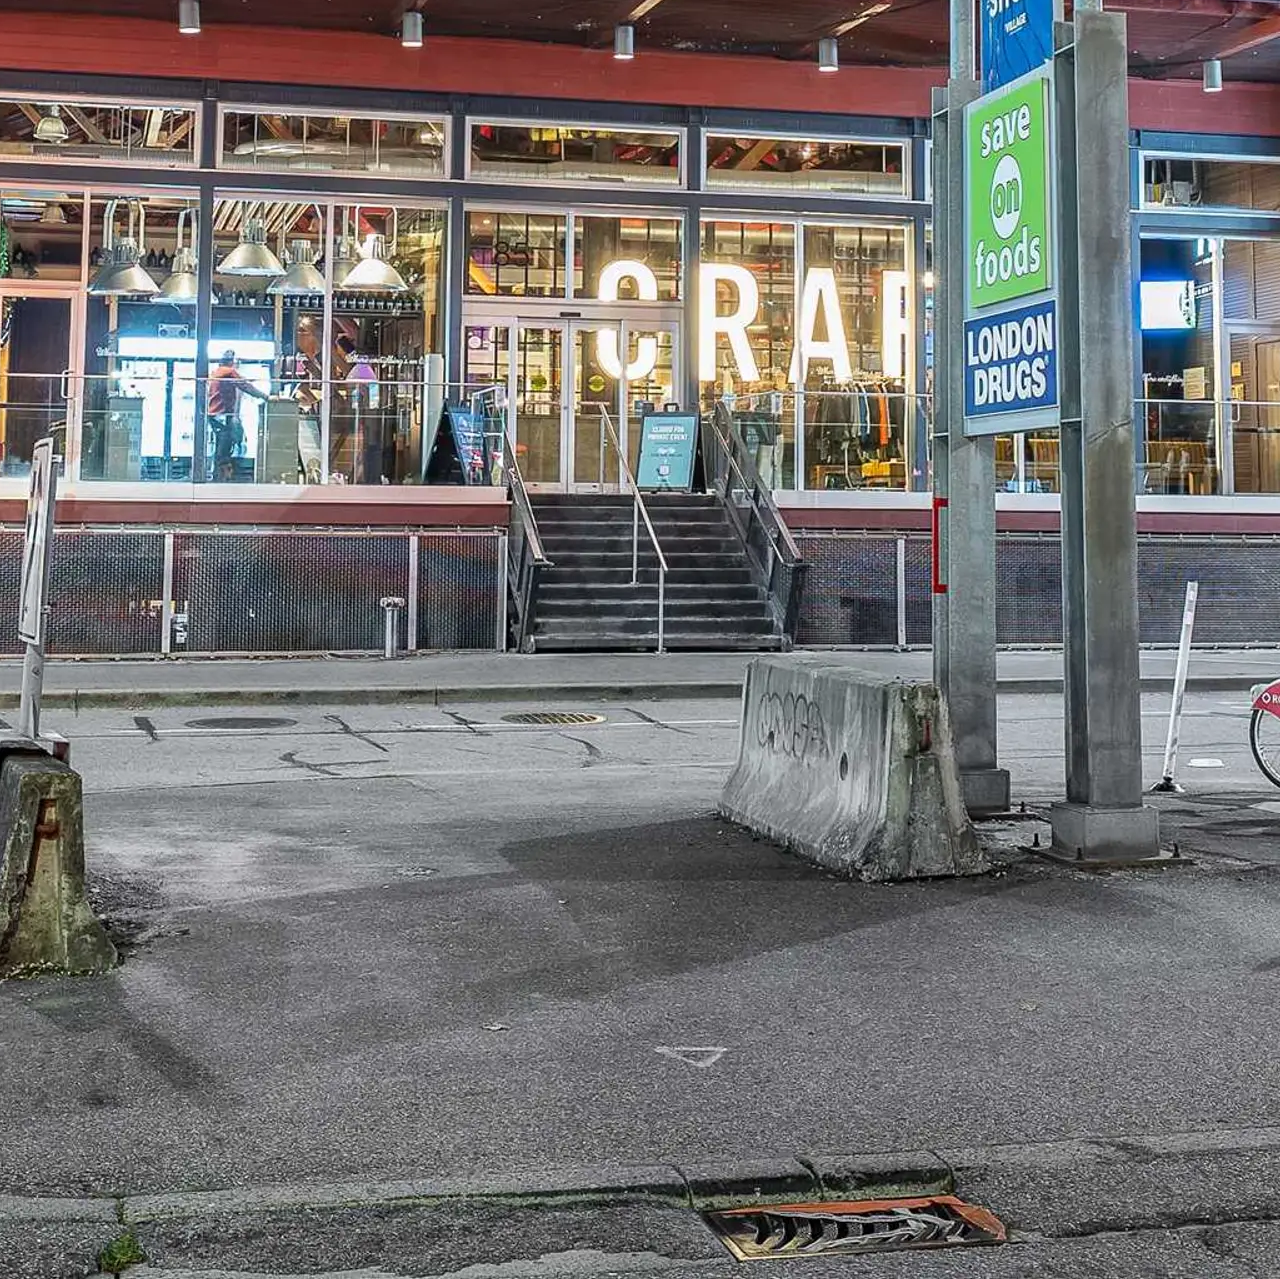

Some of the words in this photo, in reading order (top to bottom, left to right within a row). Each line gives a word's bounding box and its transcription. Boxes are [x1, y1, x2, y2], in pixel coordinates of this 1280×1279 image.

[981, 103, 1031, 160] save
[992, 177, 1020, 218] on
[976, 225, 1041, 289] foods
[967, 313, 1053, 367] LONDON
[974, 357, 1046, 407] DRUGS
